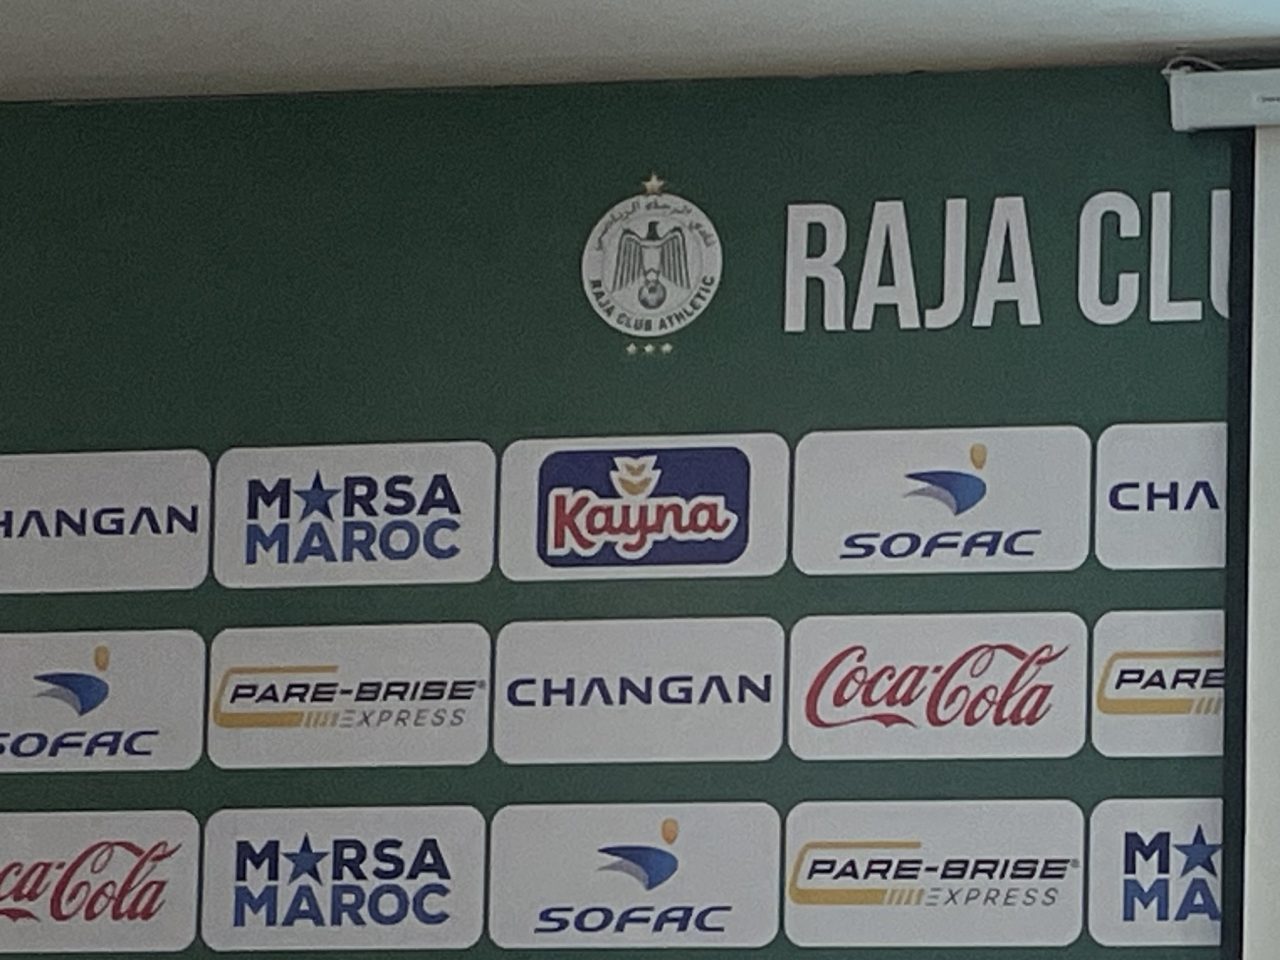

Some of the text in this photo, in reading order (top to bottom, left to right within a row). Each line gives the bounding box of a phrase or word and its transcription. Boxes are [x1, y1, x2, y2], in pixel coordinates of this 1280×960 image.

[785, 197, 1041, 331] RAJA
[591, 275, 715, 331] RAJA CLUB ATHLETIC
[554, 494, 731, 553] Kayna
[245, 519, 460, 564] MAROC
[840, 530, 1041, 559] SOFAC
[230, 680, 475, 703] PARE-BRISE
[507, 675, 771, 706] CHANGAN
[805, 644, 1068, 728] Coca-Cola
[1114, 667, 1224, 690] PARE
[339, 708, 468, 728] EXPRESS
[0, 731, 159, 757] OFAC
[805, 857, 1071, 881] PARE-BRISE
[233, 883, 450, 927] MAROC
[924, 887, 1058, 907] EXPRESS
[534, 906, 732, 933] SOFAC
